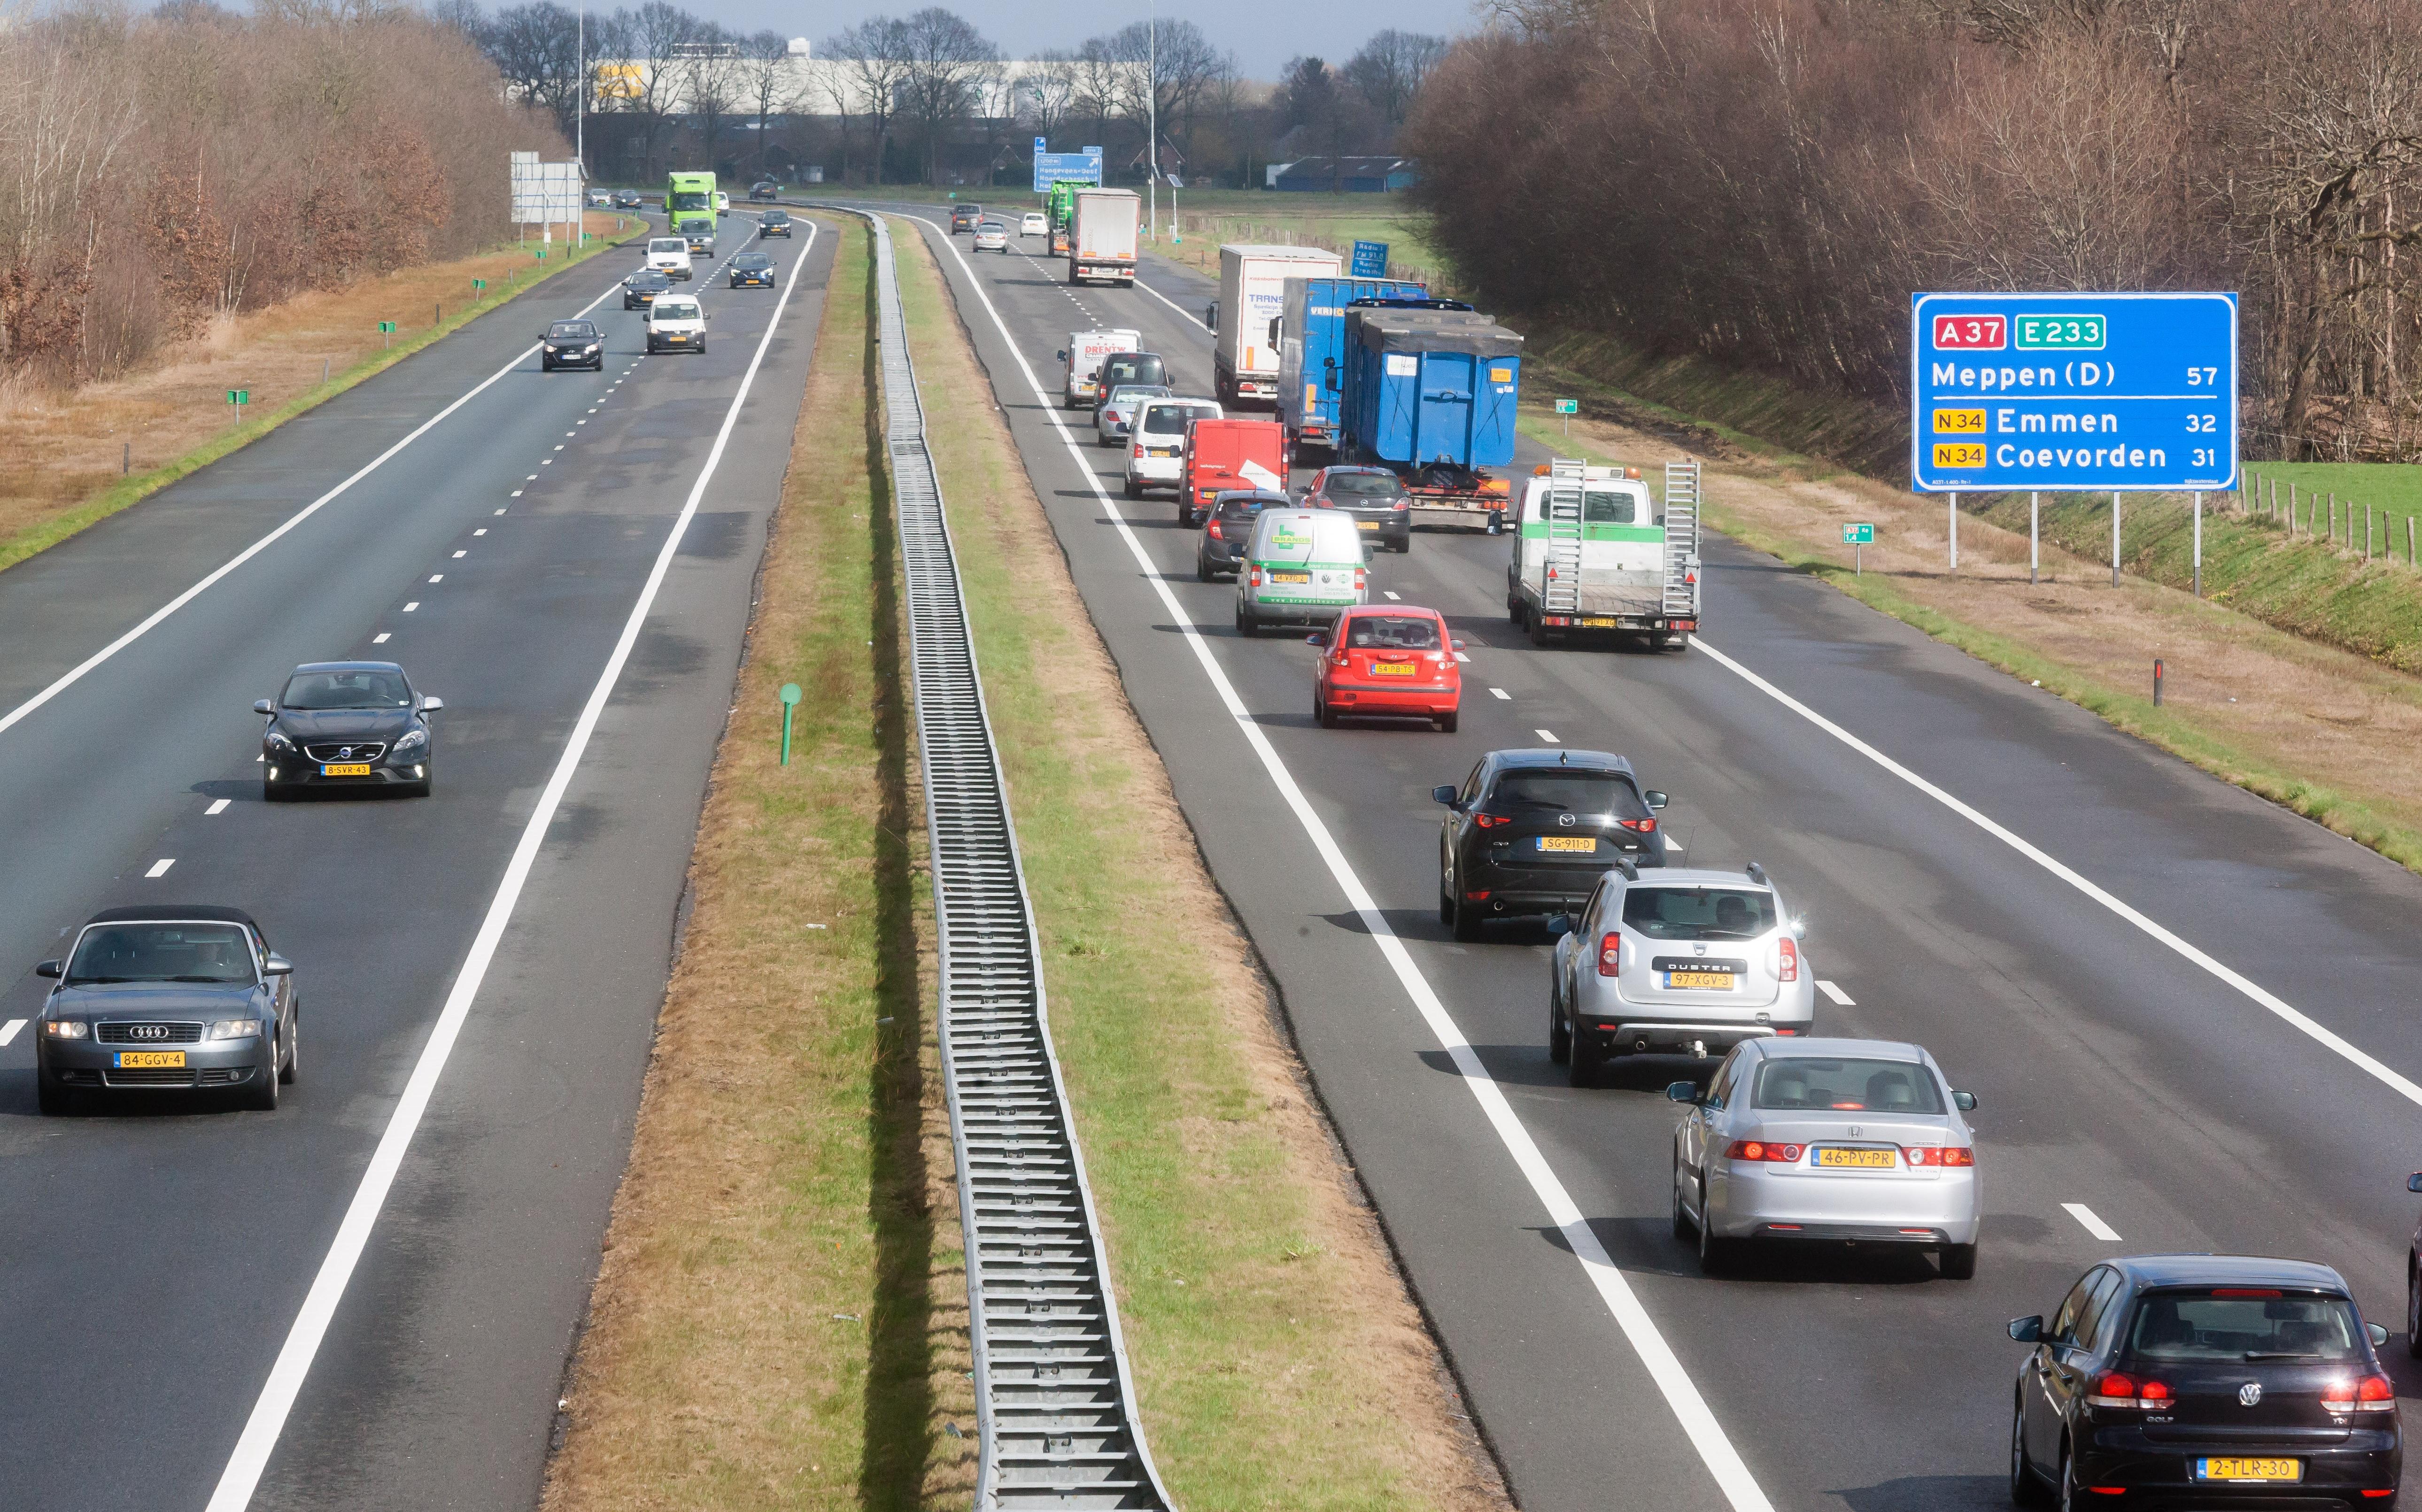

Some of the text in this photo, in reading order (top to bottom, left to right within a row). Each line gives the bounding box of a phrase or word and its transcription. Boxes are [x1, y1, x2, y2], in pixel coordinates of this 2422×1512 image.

[1933, 361, 2217, 390] Meppen (D) 57
[1998, 409, 2117, 432] Emmen
[2185, 414, 2216, 432] 32
[1996, 443, 2166, 468] Coevorden
[2191, 448, 2214, 467] 31
[1548, 839, 1590, 849] SG-911-D
[1676, 974, 1729, 986] 97-XGV-3
[124, 1054, 181, 1065] 84-GGV-4
[1825, 1151, 1889, 1165] 46-PV-PR
[2213, 1460, 2290, 1476] 2-TLR-30
